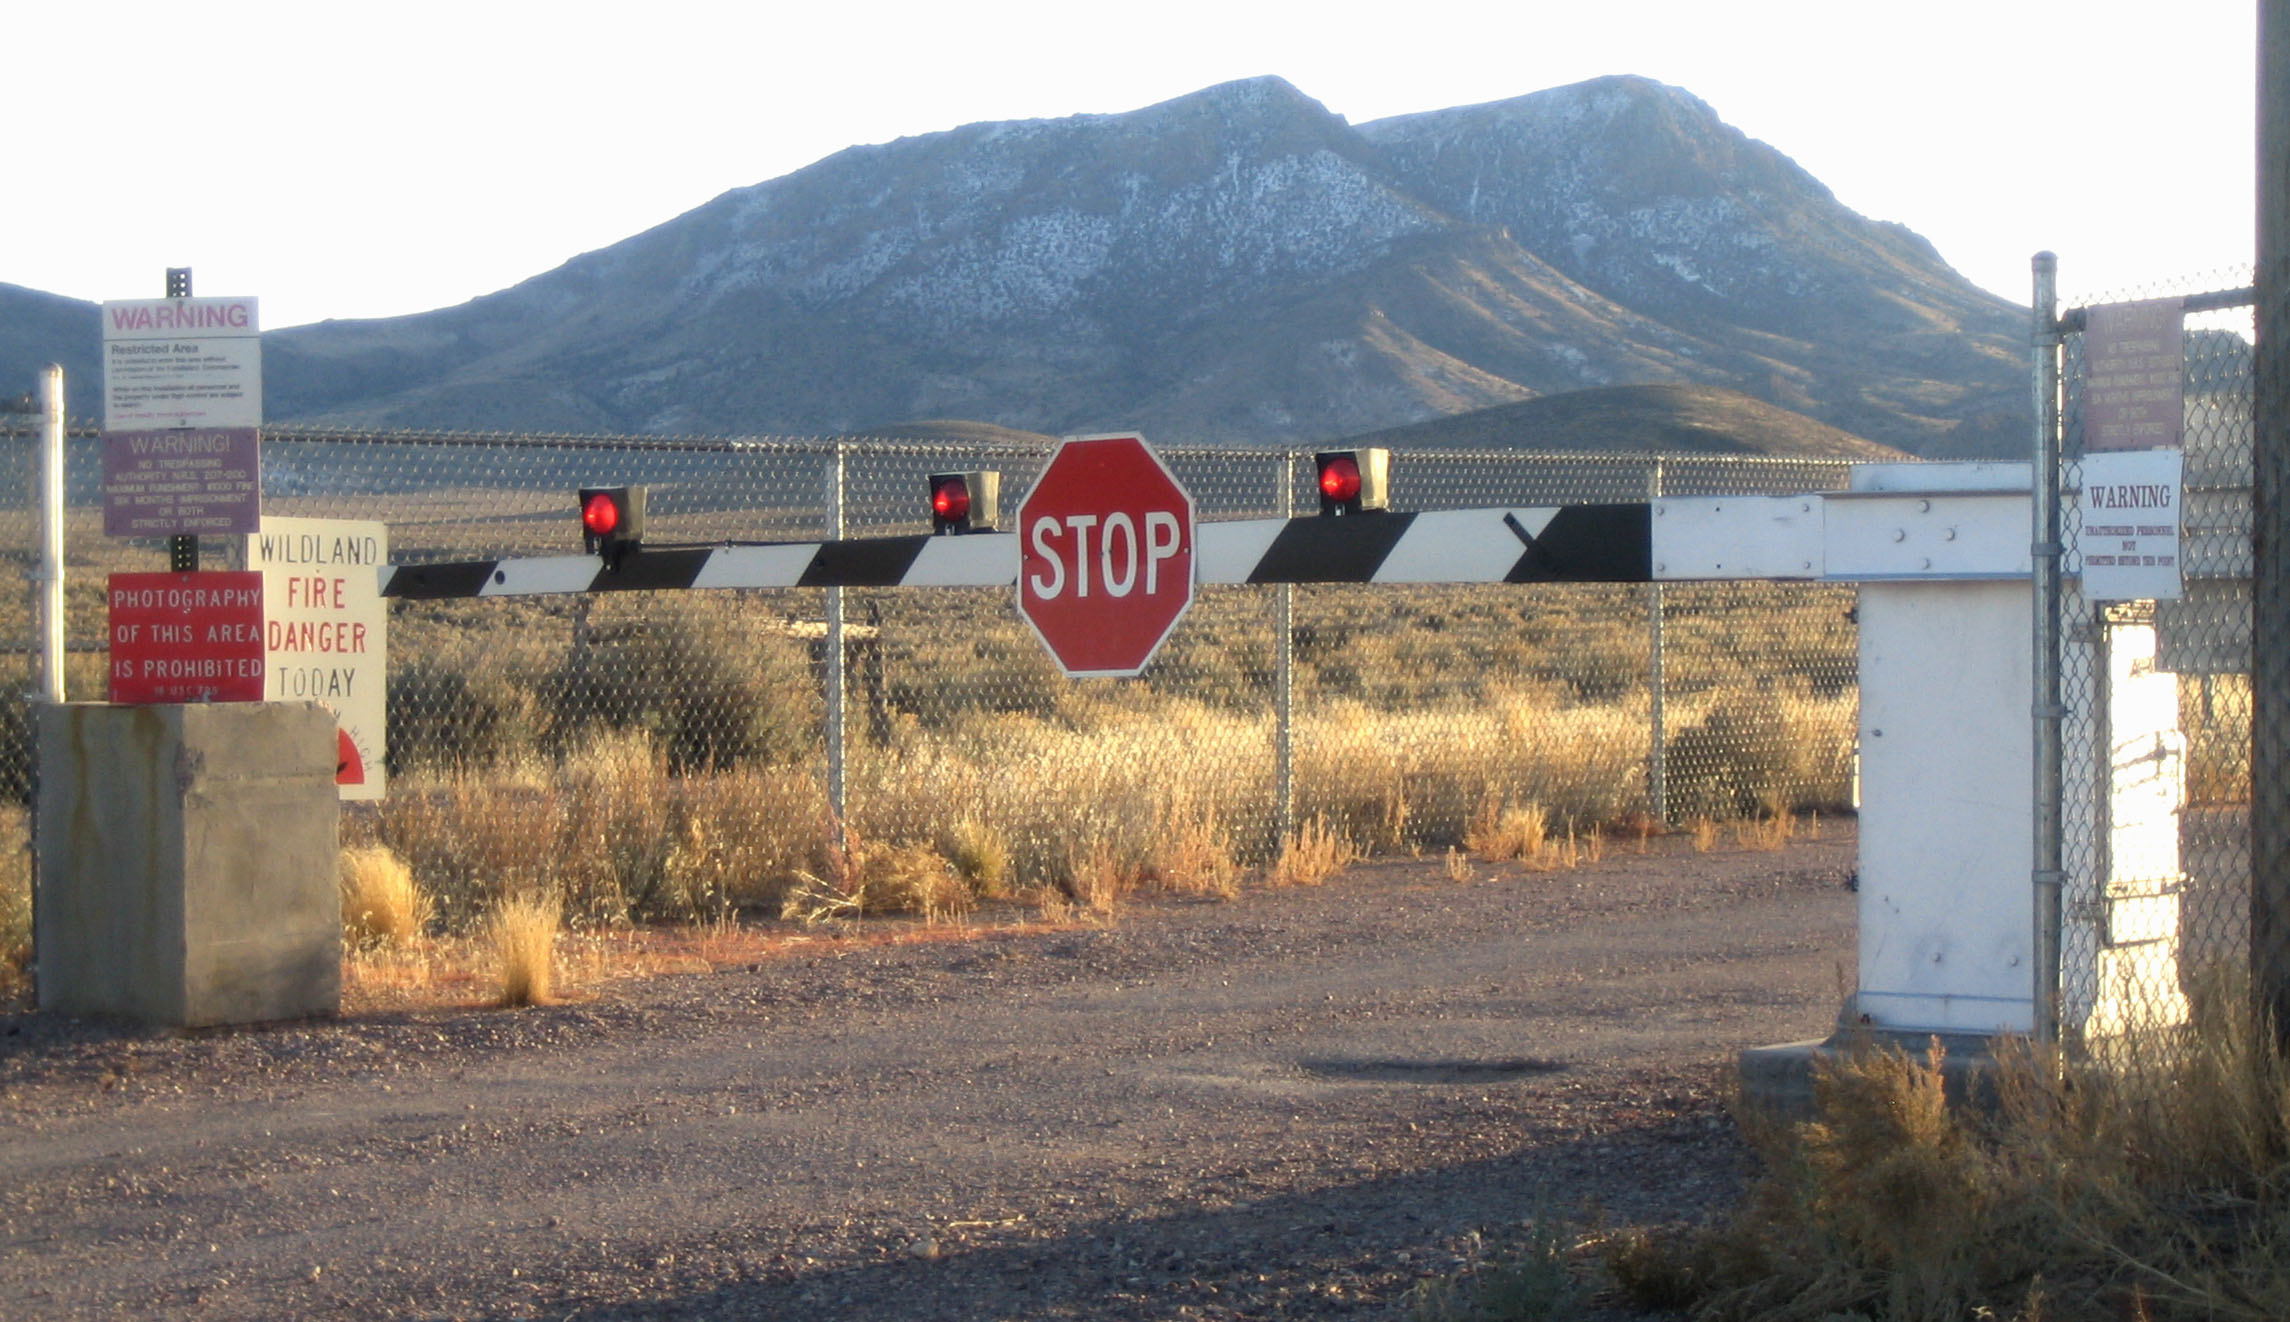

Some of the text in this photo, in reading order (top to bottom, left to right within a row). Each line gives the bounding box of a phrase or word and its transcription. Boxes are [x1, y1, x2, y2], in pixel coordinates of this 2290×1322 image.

[112, 304, 249, 330] WARNING
[111, 343, 198, 355] Restricted Area
[129, 434, 231, 454] WARNING!
[138, 460, 152, 469] NO
[2090, 485, 2171, 509] WARNING
[131, 518, 178, 528] STRICTLY
[260, 535, 377, 565] WILDLAND
[1031, 511, 1181, 600] STOP
[114, 588, 261, 609] PHOTOGRAPHY
[288, 577, 346, 609] FIRE
[117, 624, 261, 643] OF THIS AREA
[268, 620, 367, 653] DANGER
[115, 659, 262, 678] IS PROHIBITED
[279, 667, 355, 698] TODAY
